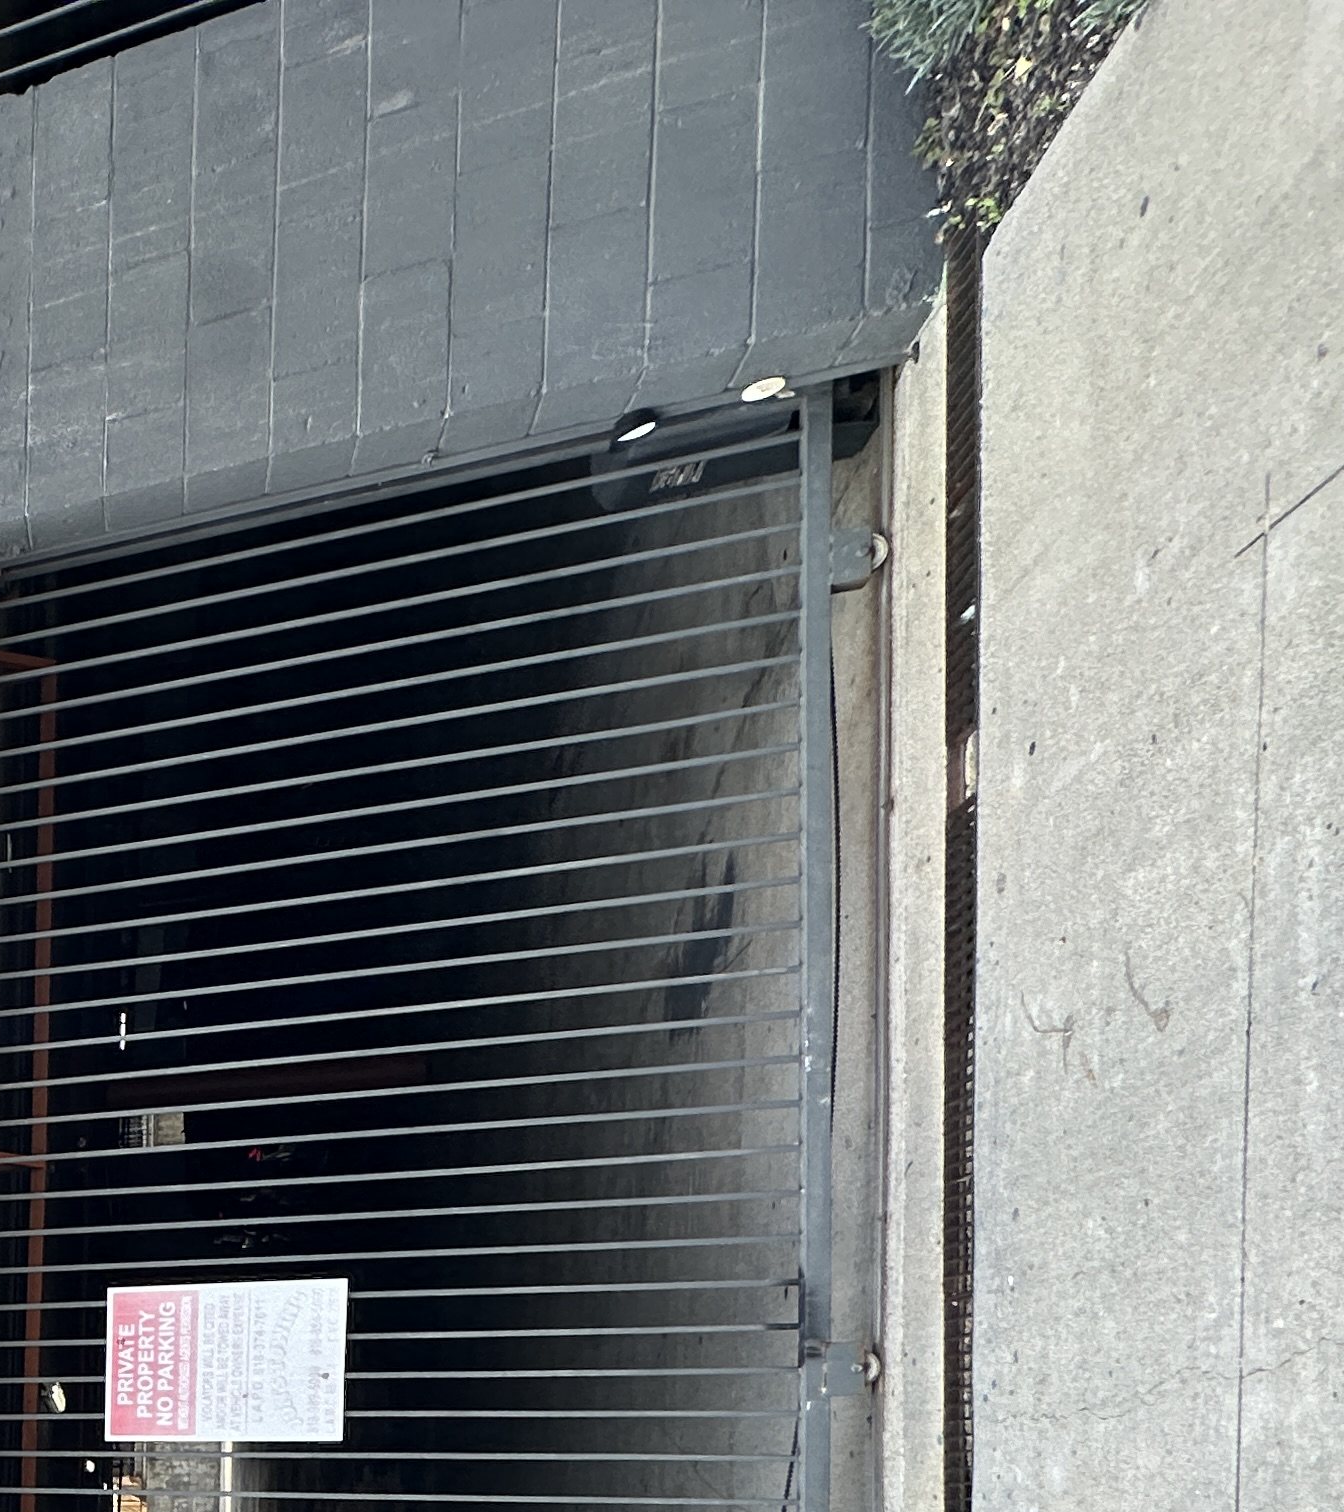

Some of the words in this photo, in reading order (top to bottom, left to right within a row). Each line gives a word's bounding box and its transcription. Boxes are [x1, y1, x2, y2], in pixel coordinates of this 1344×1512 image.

[116, 1323, 135, 1406] PRIVATE
[136, 1309, 156, 1418] PROPERTY
[157, 1301, 176, 1391] PARKING
[156, 1397, 174, 1426] NO
